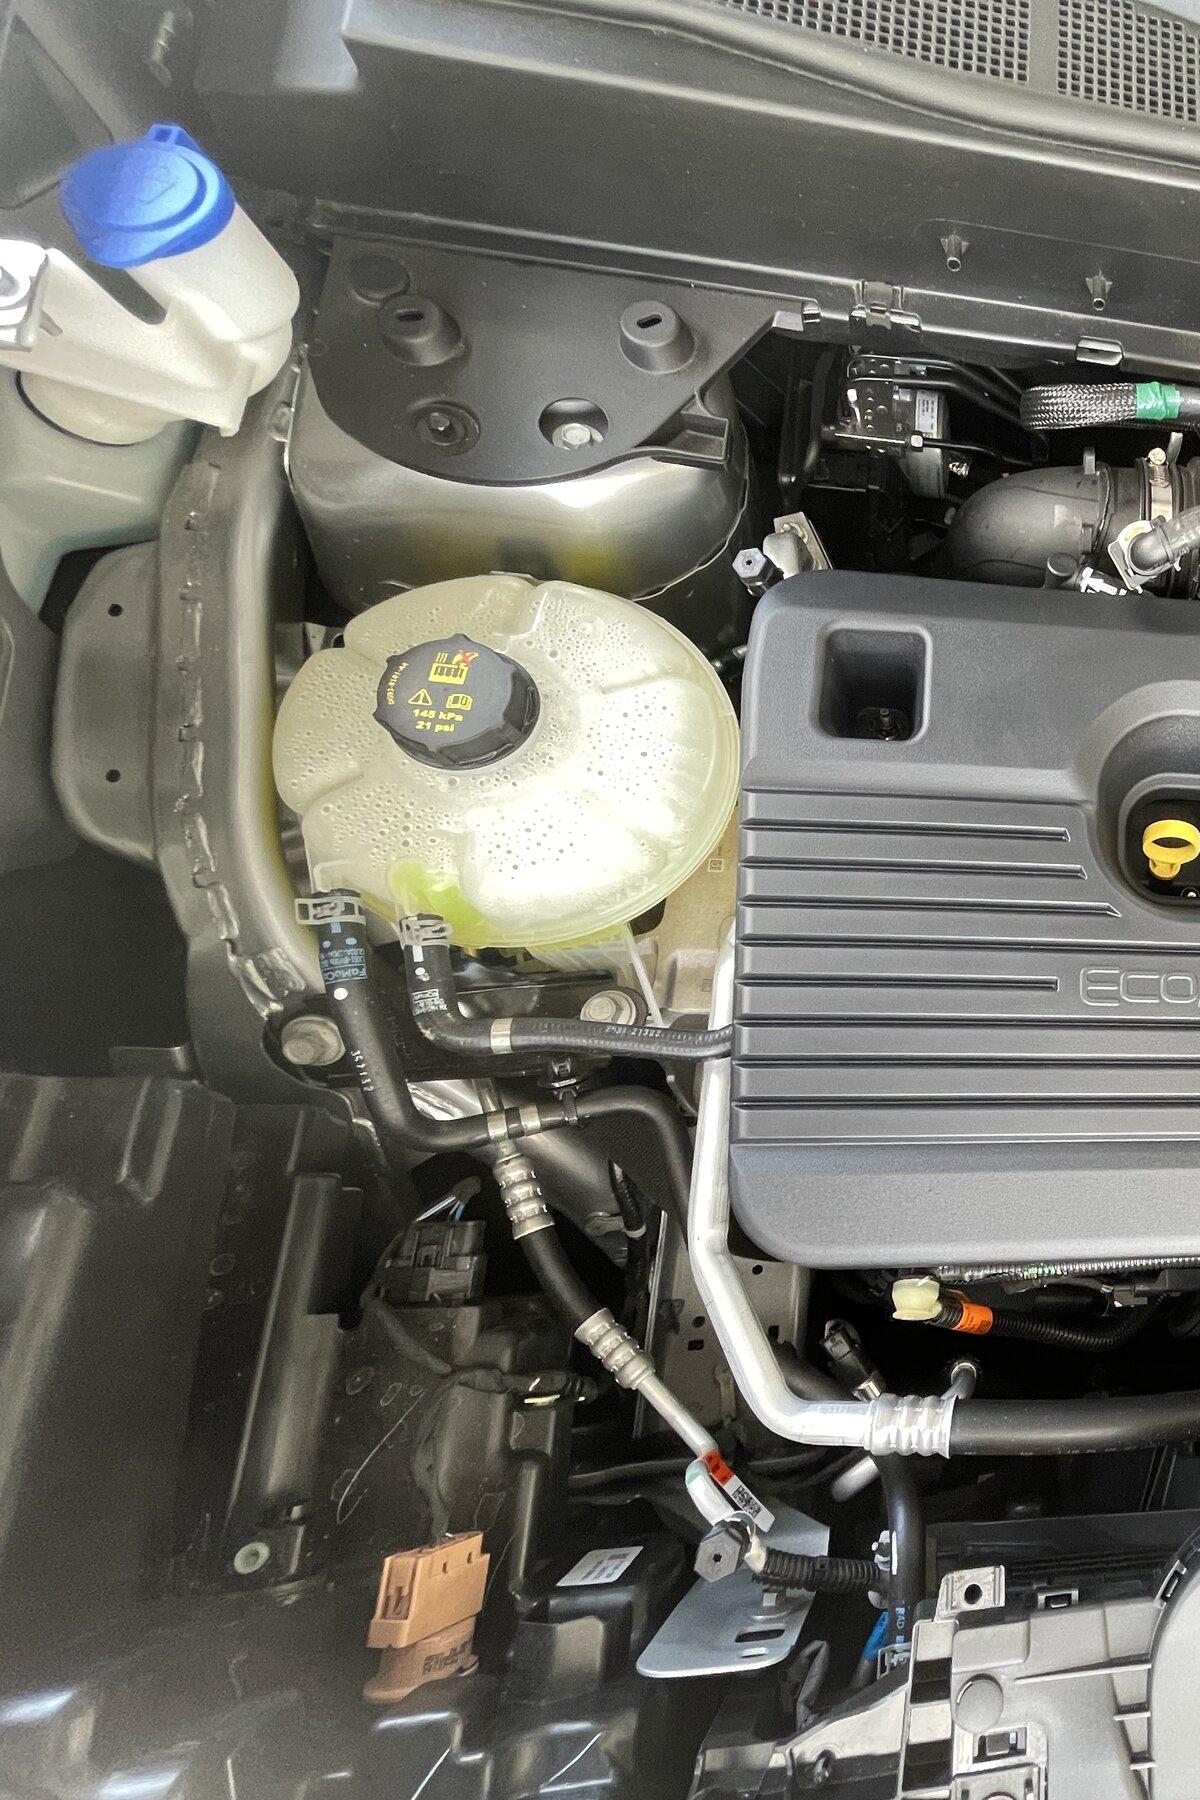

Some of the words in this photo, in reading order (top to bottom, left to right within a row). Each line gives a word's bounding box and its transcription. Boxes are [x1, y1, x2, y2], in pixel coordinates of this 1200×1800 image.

[413, 708, 436, 719] 145
[438, 710, 463, 722] kPa
[416, 720, 432, 730] 21
[434, 723, 455, 733] psi
